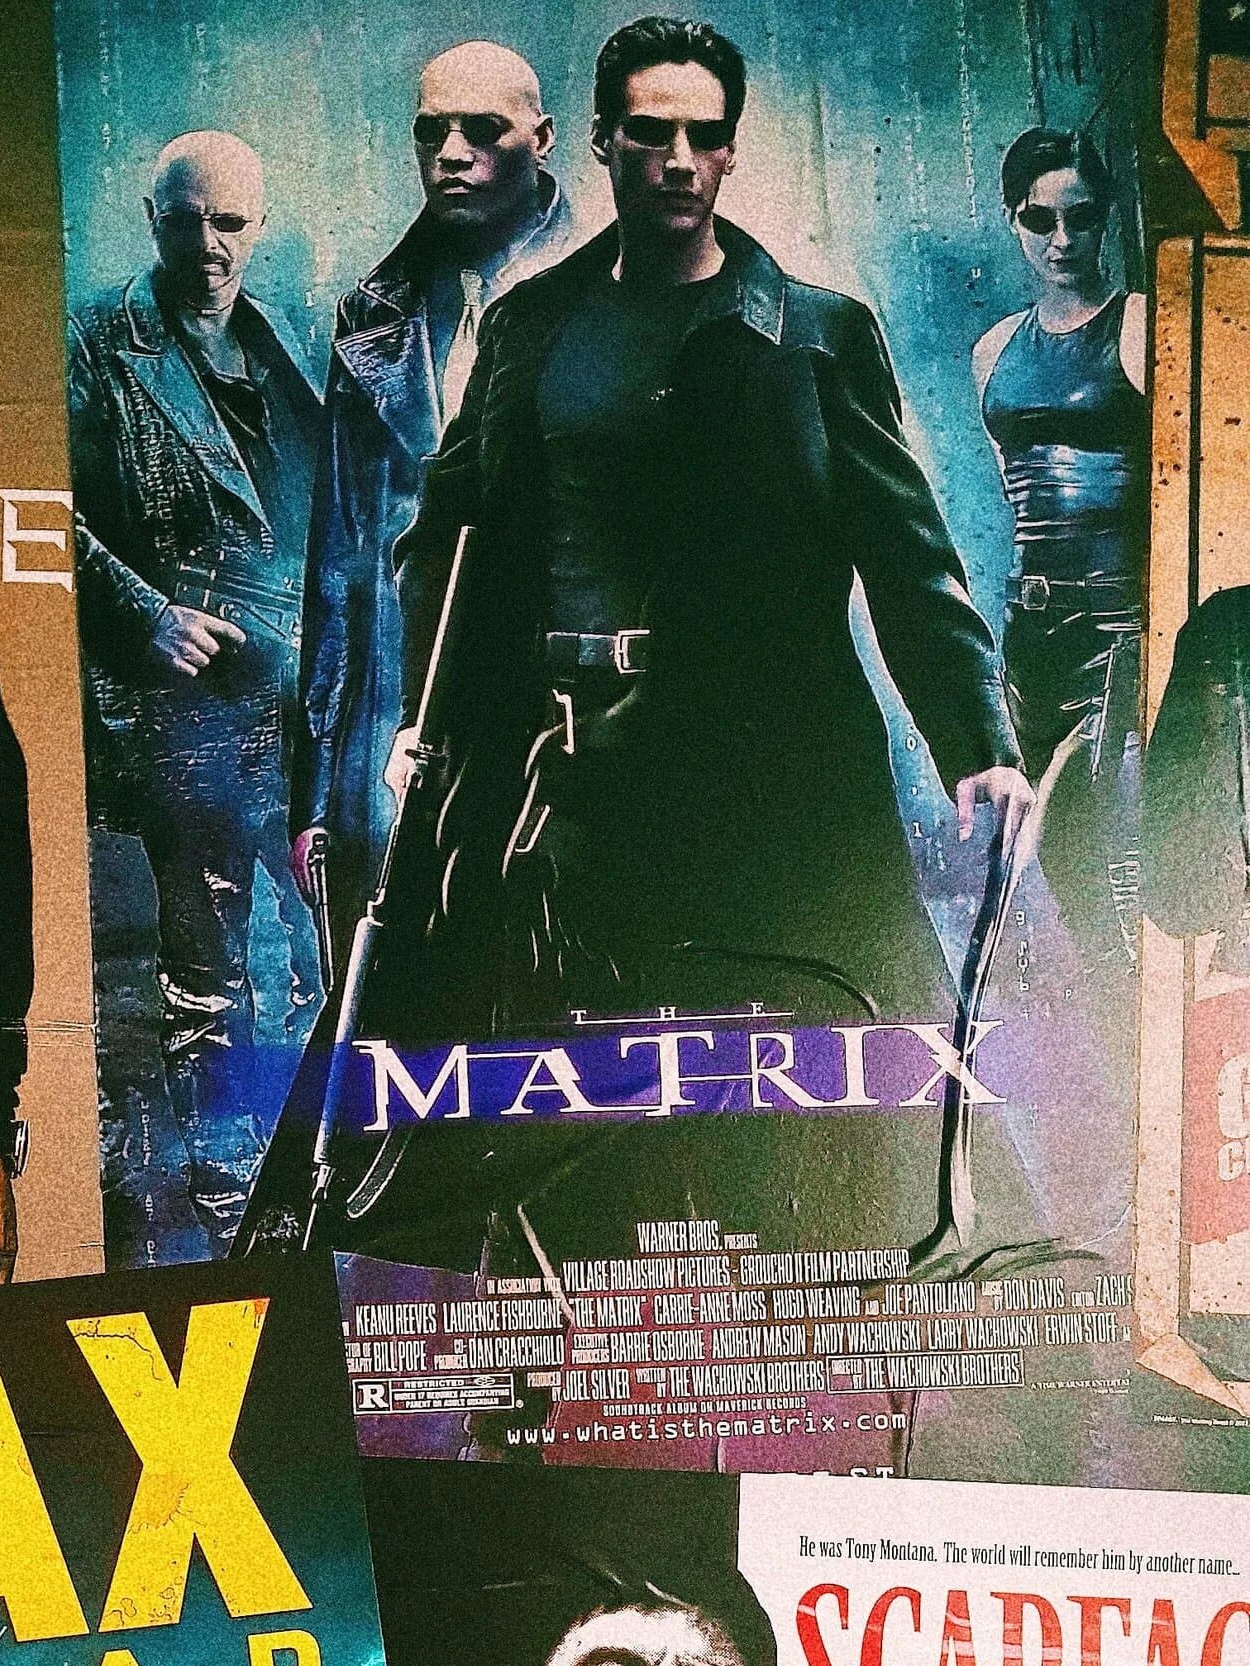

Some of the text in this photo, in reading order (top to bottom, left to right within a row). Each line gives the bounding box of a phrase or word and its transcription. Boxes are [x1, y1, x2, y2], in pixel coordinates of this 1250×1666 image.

[570, 1001, 766, 1024] THE
[352, 1018, 1008, 1133] MATRIX
[636, 1221, 687, 1253] WARNER
[688, 1219, 723, 1251] BROS.
[562, 1260, 609, 1292] VILLAGE
[610, 1257, 676, 1291] ROADSHOW
[677, 1254, 731, 1289] PICTURES
[739, 1252, 793, 1286] GROUCHO
[805, 1250, 832, 1283] FILM
[833, 1248, 910, 1281] PARTNERSHIP
[355, 1303, 394, 1337] KEANU
[396, 1302, 438, 1335] REEVES
[443, 1301, 500, 1334] LAURENCE
[502, 1298, 564, 1332] FISHBURNE
[654, 1291, 731, 1325] CARRIE-ANNE
[732, 1289, 767, 1321] MOSS
[773, 1287, 804, 1320] HUGO
[805, 1286, 861, 1318] WEAVING
[882, 1283, 904, 1316] JOE
[905, 1281, 975, 1315] PANTOLIANO
[1003, 1279, 1031, 1311] DON
[1032, 1276, 1065, 1309] DAVIS
[1095, 1275, 1125, 1307] ZACH
[374, 1341, 397, 1372] BILL
[398, 1339, 427, 1371] POPE
[469, 1337, 493, 1369] DAN
[494, 1334, 565, 1367] CRACCHIOLO
[611, 1311, 1118, 1363] BARRIE OSBORNE ANDREW MASON ANDY WACHOWSKI LARRY WACHOWSKI ERWIN STOFF
[563, 1369, 590, 1401] JOEL
[591, 1368, 631, 1400] SILVER
[668, 1366, 690, 1398] THE
[691, 1363, 766, 1397] WACHOWSKI
[767, 1360, 825, 1394] BROTHERS
[864, 1357, 886, 1389] THE
[888, 1354, 961, 1388] WACHOWSKI
[962, 1351, 1020, 1385] BROTHERS
[357, 1383, 389, 1409] R
[506, 1409, 908, 1446] www.whatisthematrix.com
[799, 1535, 816, 1558] He
[818, 1540, 843, 1559] was
[846, 1537, 877, 1564] Tony
[880, 1538, 938, 1563] Montana.
[944, 1541, 968, 1565] The
[971, 1542, 1005, 1566] world
[1010, 1544, 1031, 1567] will
[1034, 1546, 1098, 1570] remember
[1102, 1548, 1125, 1572] him
[1128, 1549, 1143, 1575] by
[1146, 1552, 1196, 1574] another
